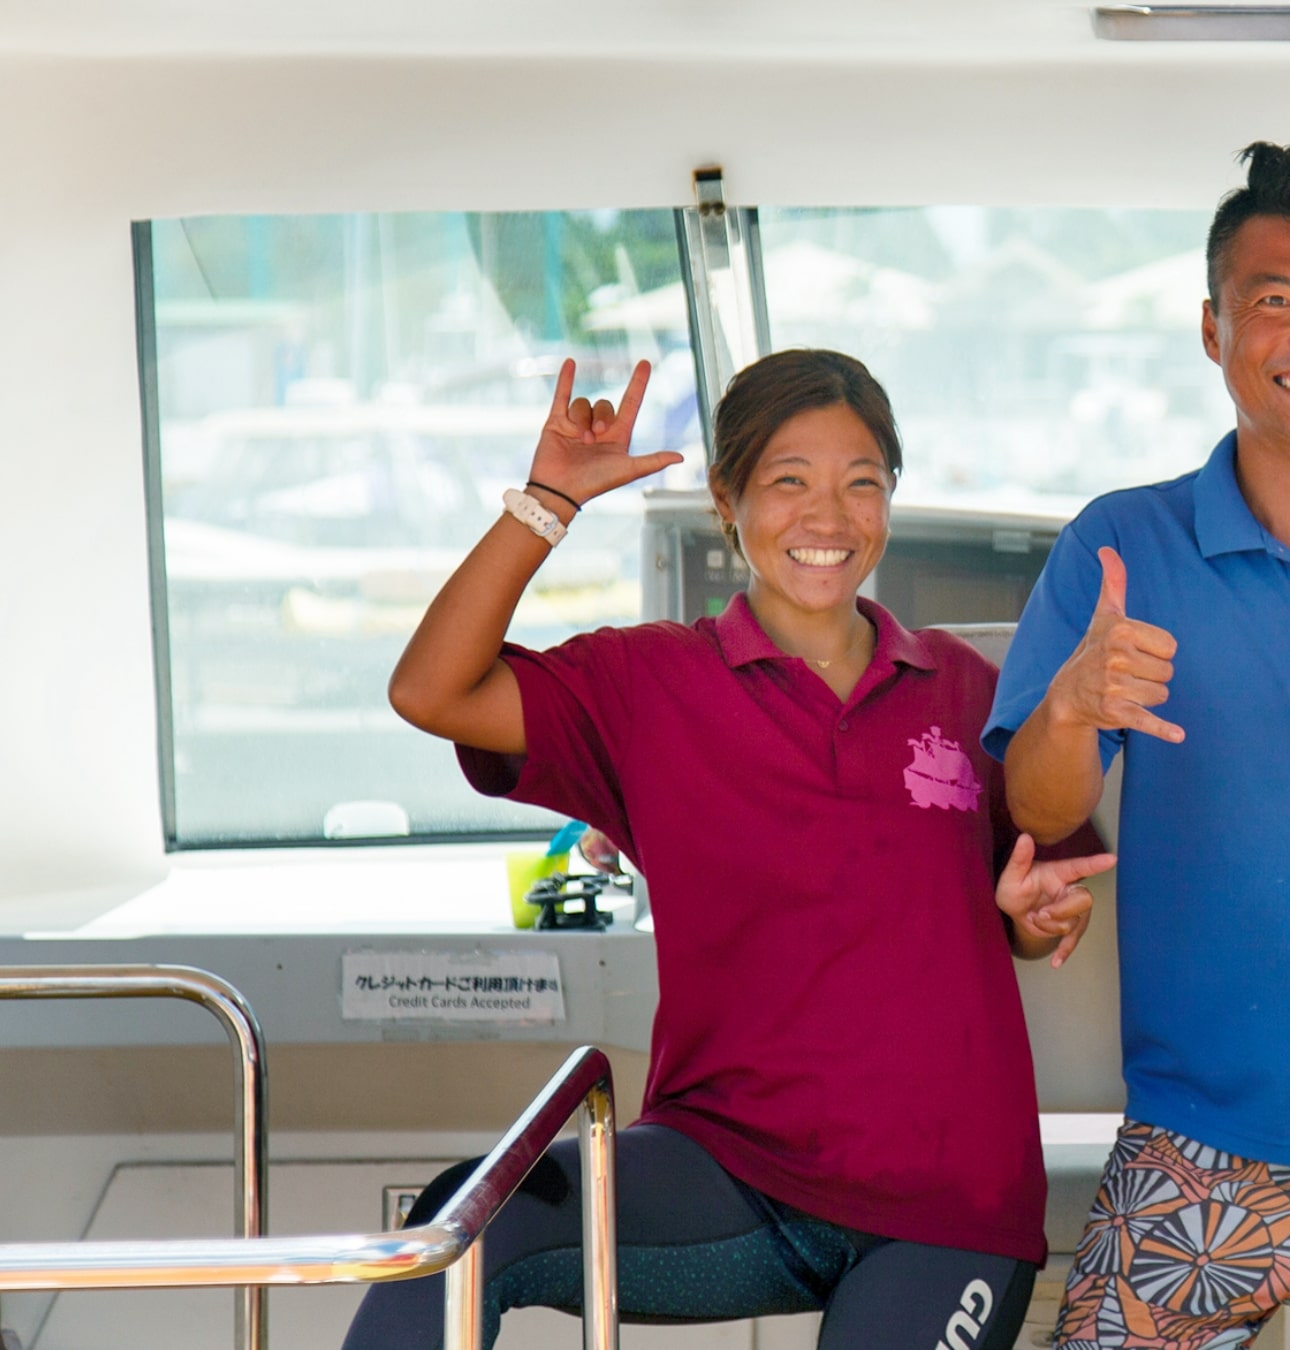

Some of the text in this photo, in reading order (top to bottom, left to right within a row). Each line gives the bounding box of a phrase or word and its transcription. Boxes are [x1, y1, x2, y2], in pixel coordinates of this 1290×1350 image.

[388, 995, 530, 1011] Credit Cards Accepted
[934, 1278, 994, 1350] GU
